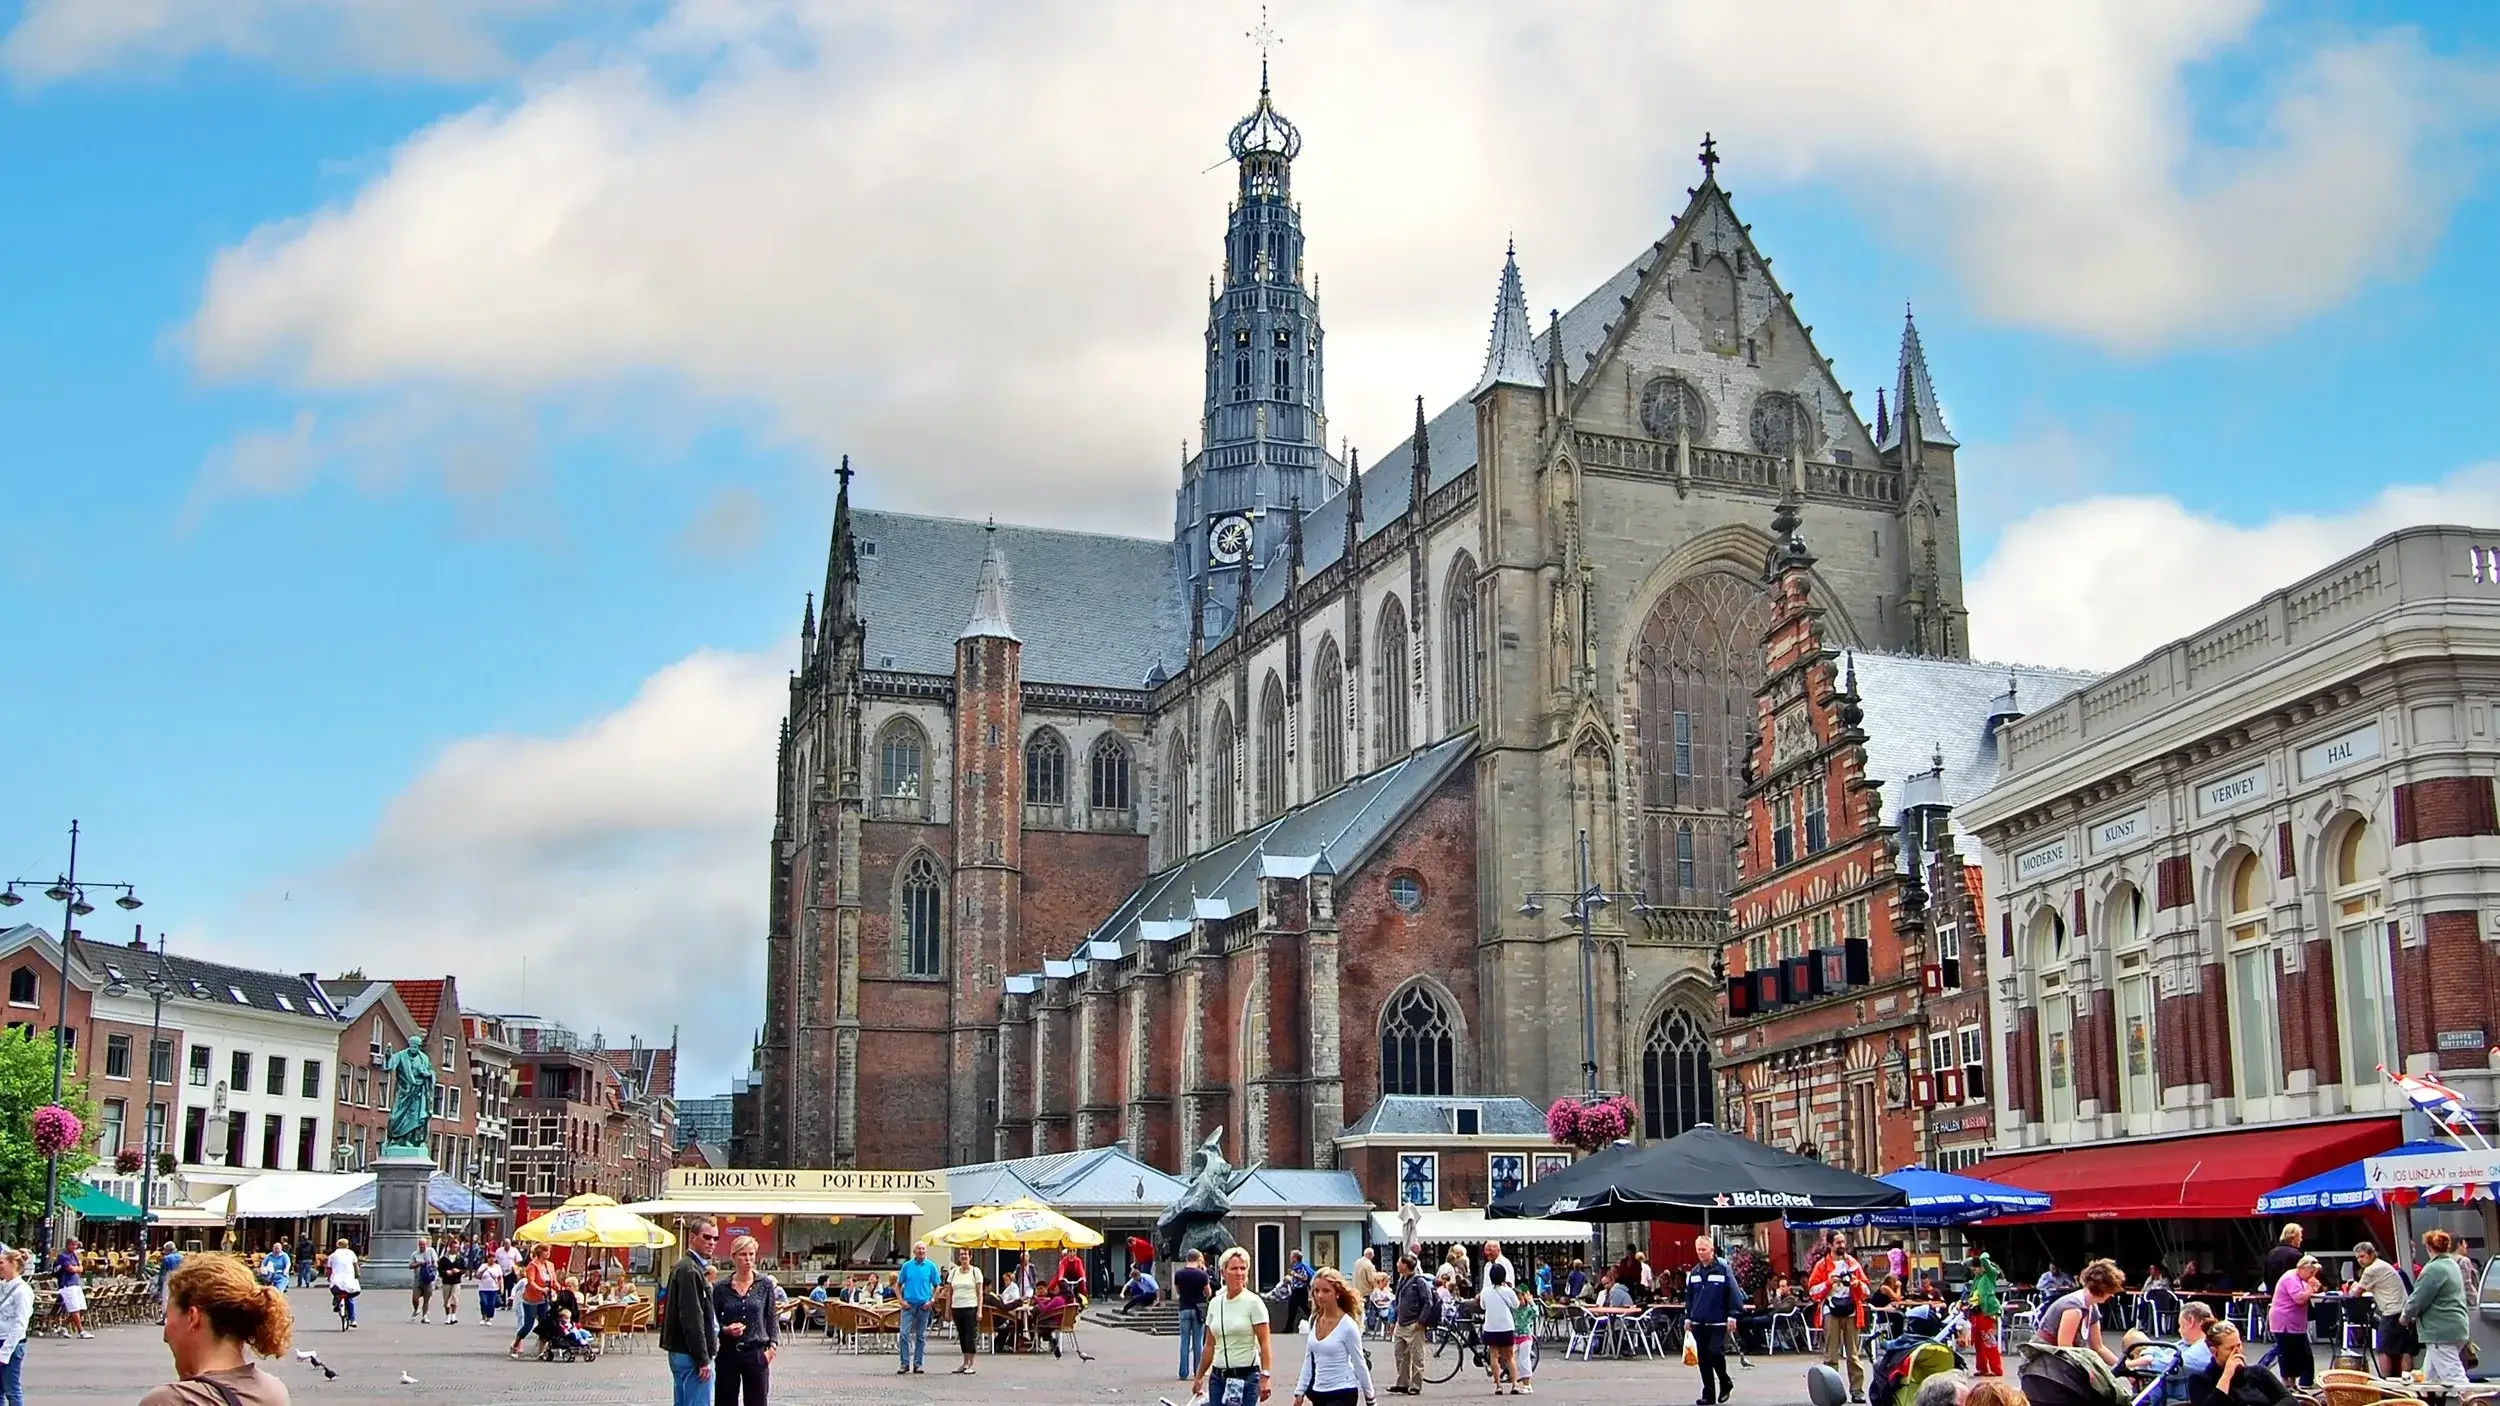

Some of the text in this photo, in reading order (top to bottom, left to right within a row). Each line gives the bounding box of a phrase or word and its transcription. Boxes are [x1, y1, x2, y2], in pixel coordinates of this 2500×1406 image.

[2328, 742, 2352, 764] HAL
[2211, 776, 2255, 803] VERWEY
[2104, 819, 2136, 842] KUNST
[2022, 845, 2063, 872] MODERNE
[822, 1174, 936, 1189] POFFERTJES
[2393, 1170, 2407, 1181] JOS
[1731, 1190, 1814, 1207] Heineken
